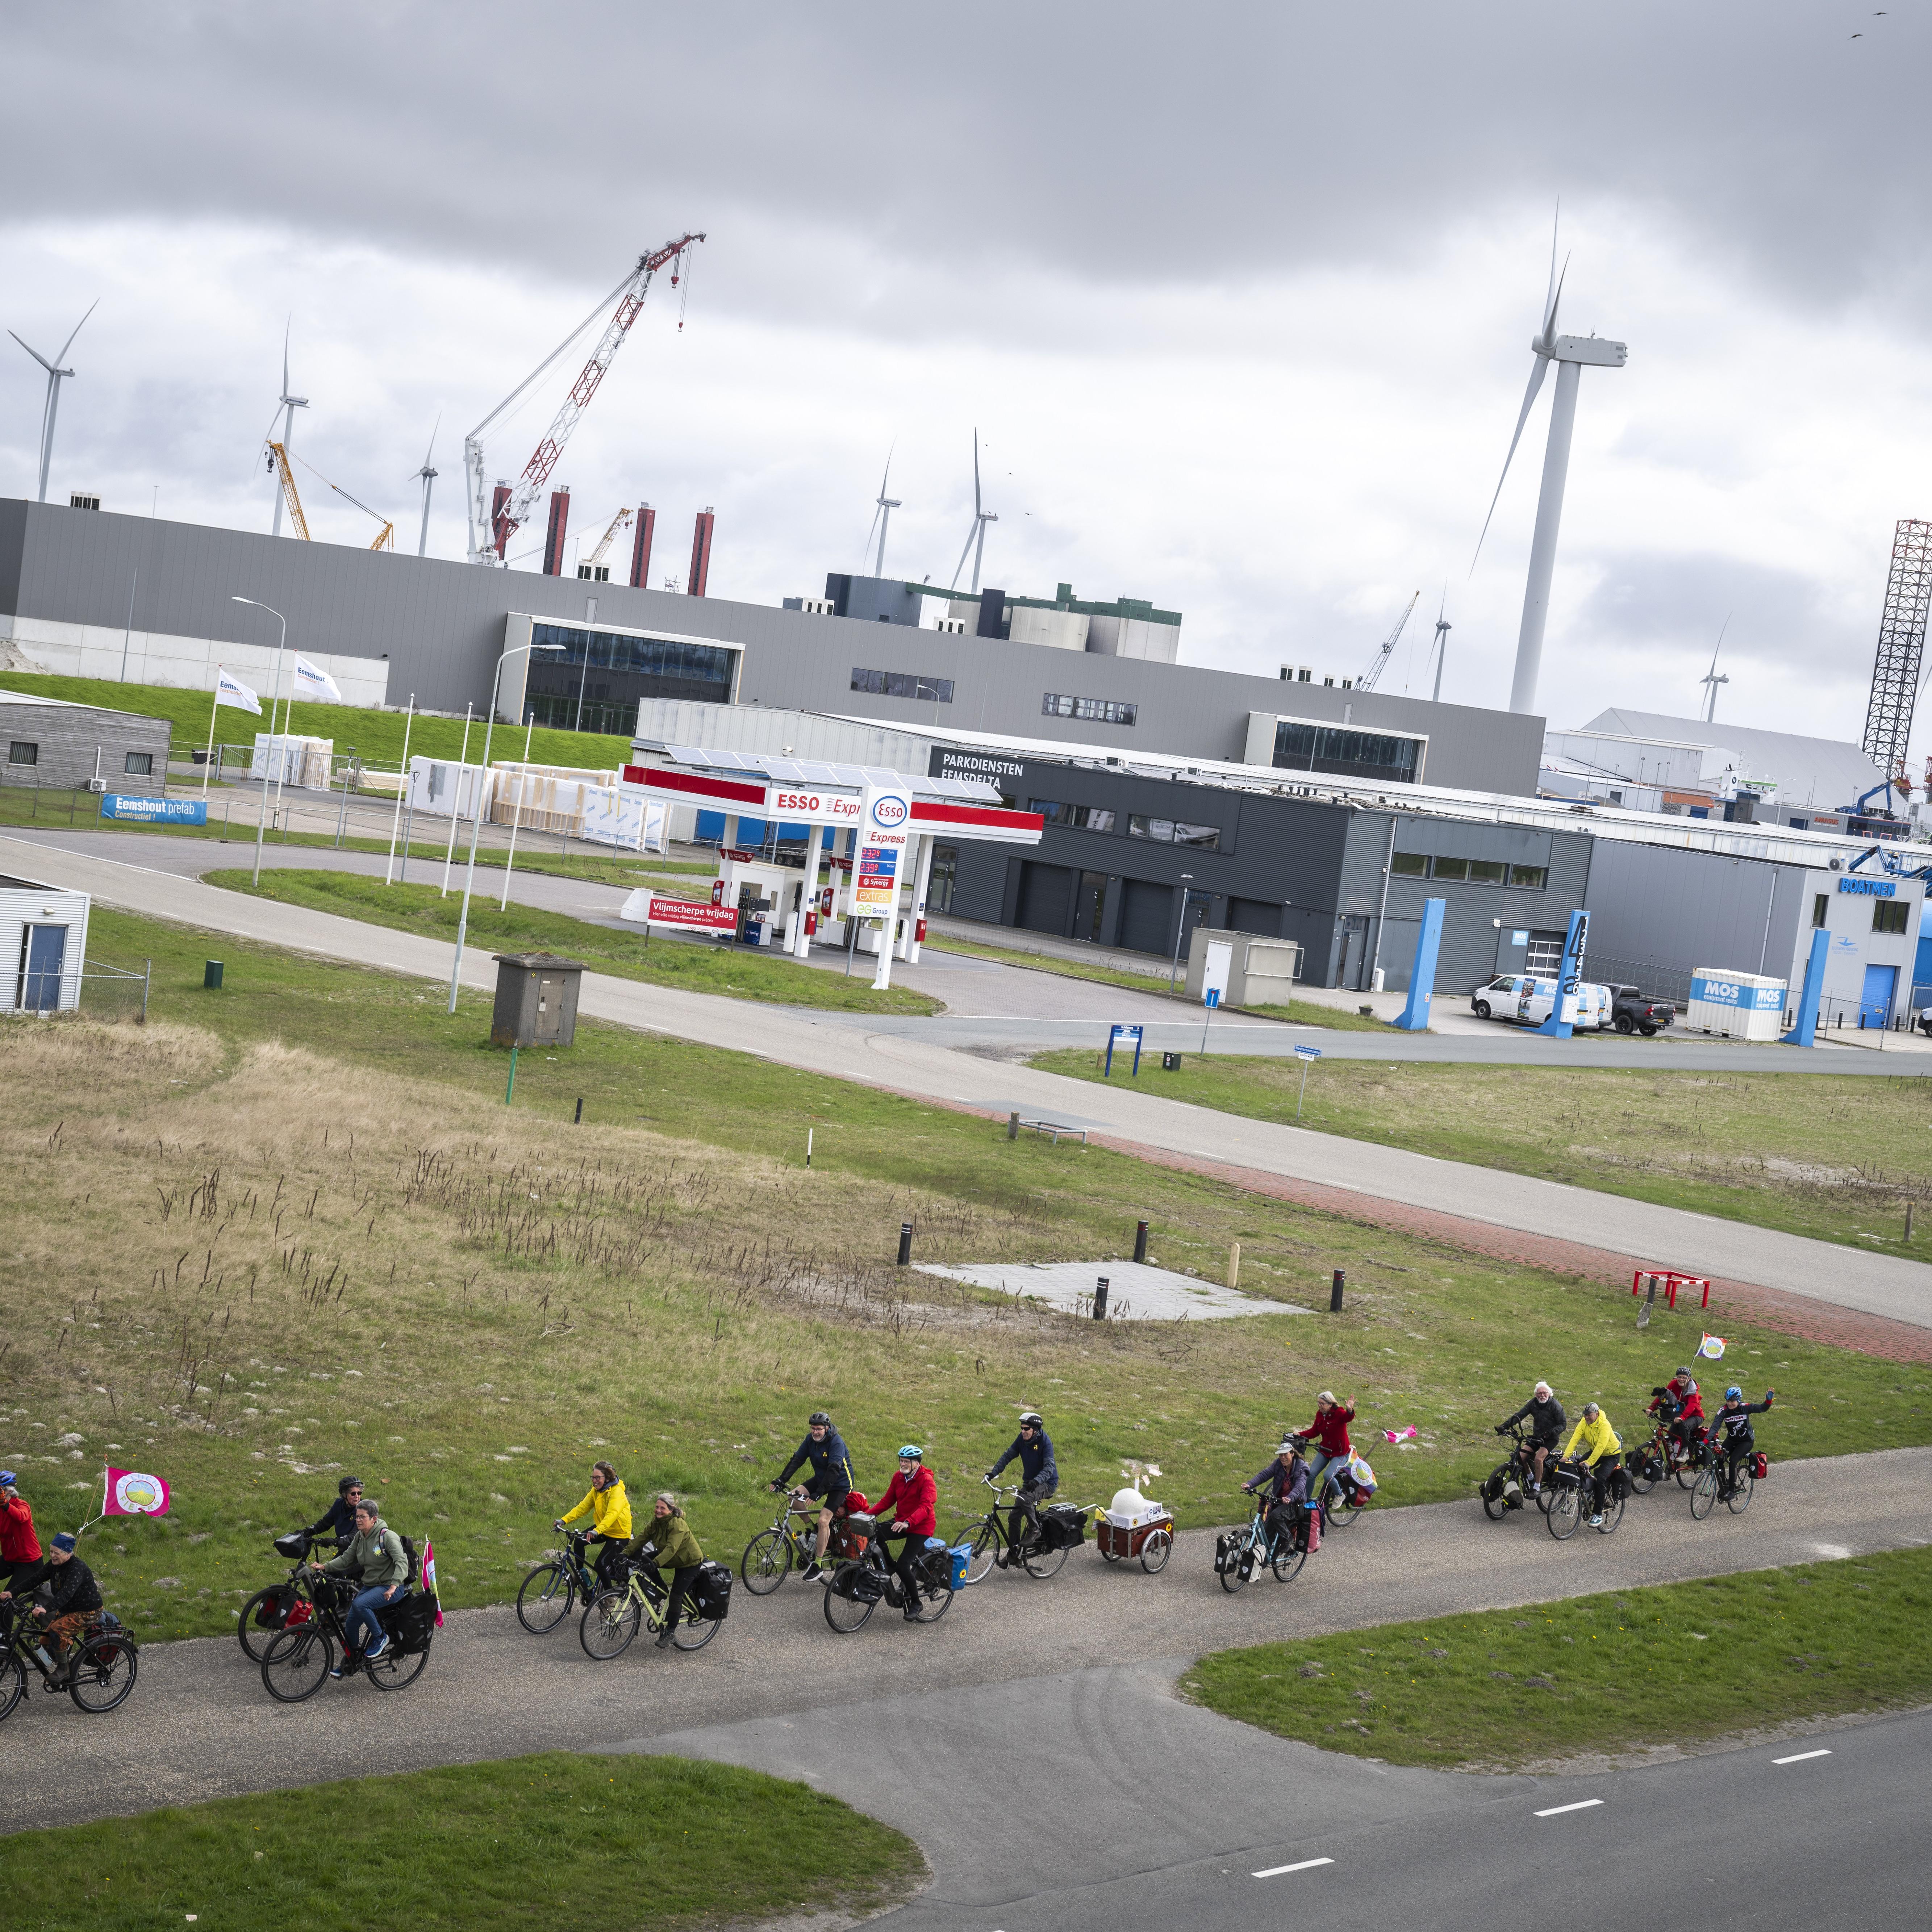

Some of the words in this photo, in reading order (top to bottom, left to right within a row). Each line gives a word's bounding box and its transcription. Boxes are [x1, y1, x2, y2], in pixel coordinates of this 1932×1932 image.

[298, 667, 325, 682] Eemshout
[943, 754, 1023, 776] PARKDIENSTEN
[942, 769, 1001, 789] EEMSDELTA
[116, 797, 166, 813] Eemshout
[168, 802, 194, 815] prefab
[778, 794, 819, 810] ESSO
[115, 810, 152, 820] Constructief
[879, 804, 903, 818] Esso
[871, 832, 906, 844] Express
[870, 879, 889, 887] Synergy
[1839, 877, 1896, 897] BOATMEN
[653, 902, 705, 916] Vlijmscherpe
[706, 909, 734, 920] vrijdag
[1585, 917, 1589, 929] 1
[1581, 929, 1587, 942] 2
[1579, 942, 1585, 955] 3
[1577, 956, 1583, 968] 4
[1574, 969, 1581, 981] 5
[1573, 982, 1579, 995] 6
[1704, 981, 1739, 998] MOS
[1757, 989, 1781, 1002] MOS
[1295, 1046, 1320, 1055] Westereemsweg
[118, 1478, 129, 1489] DE
[131, 1474, 162, 1493] LUCHT
[120, 1495, 159, 1511] FIERS
